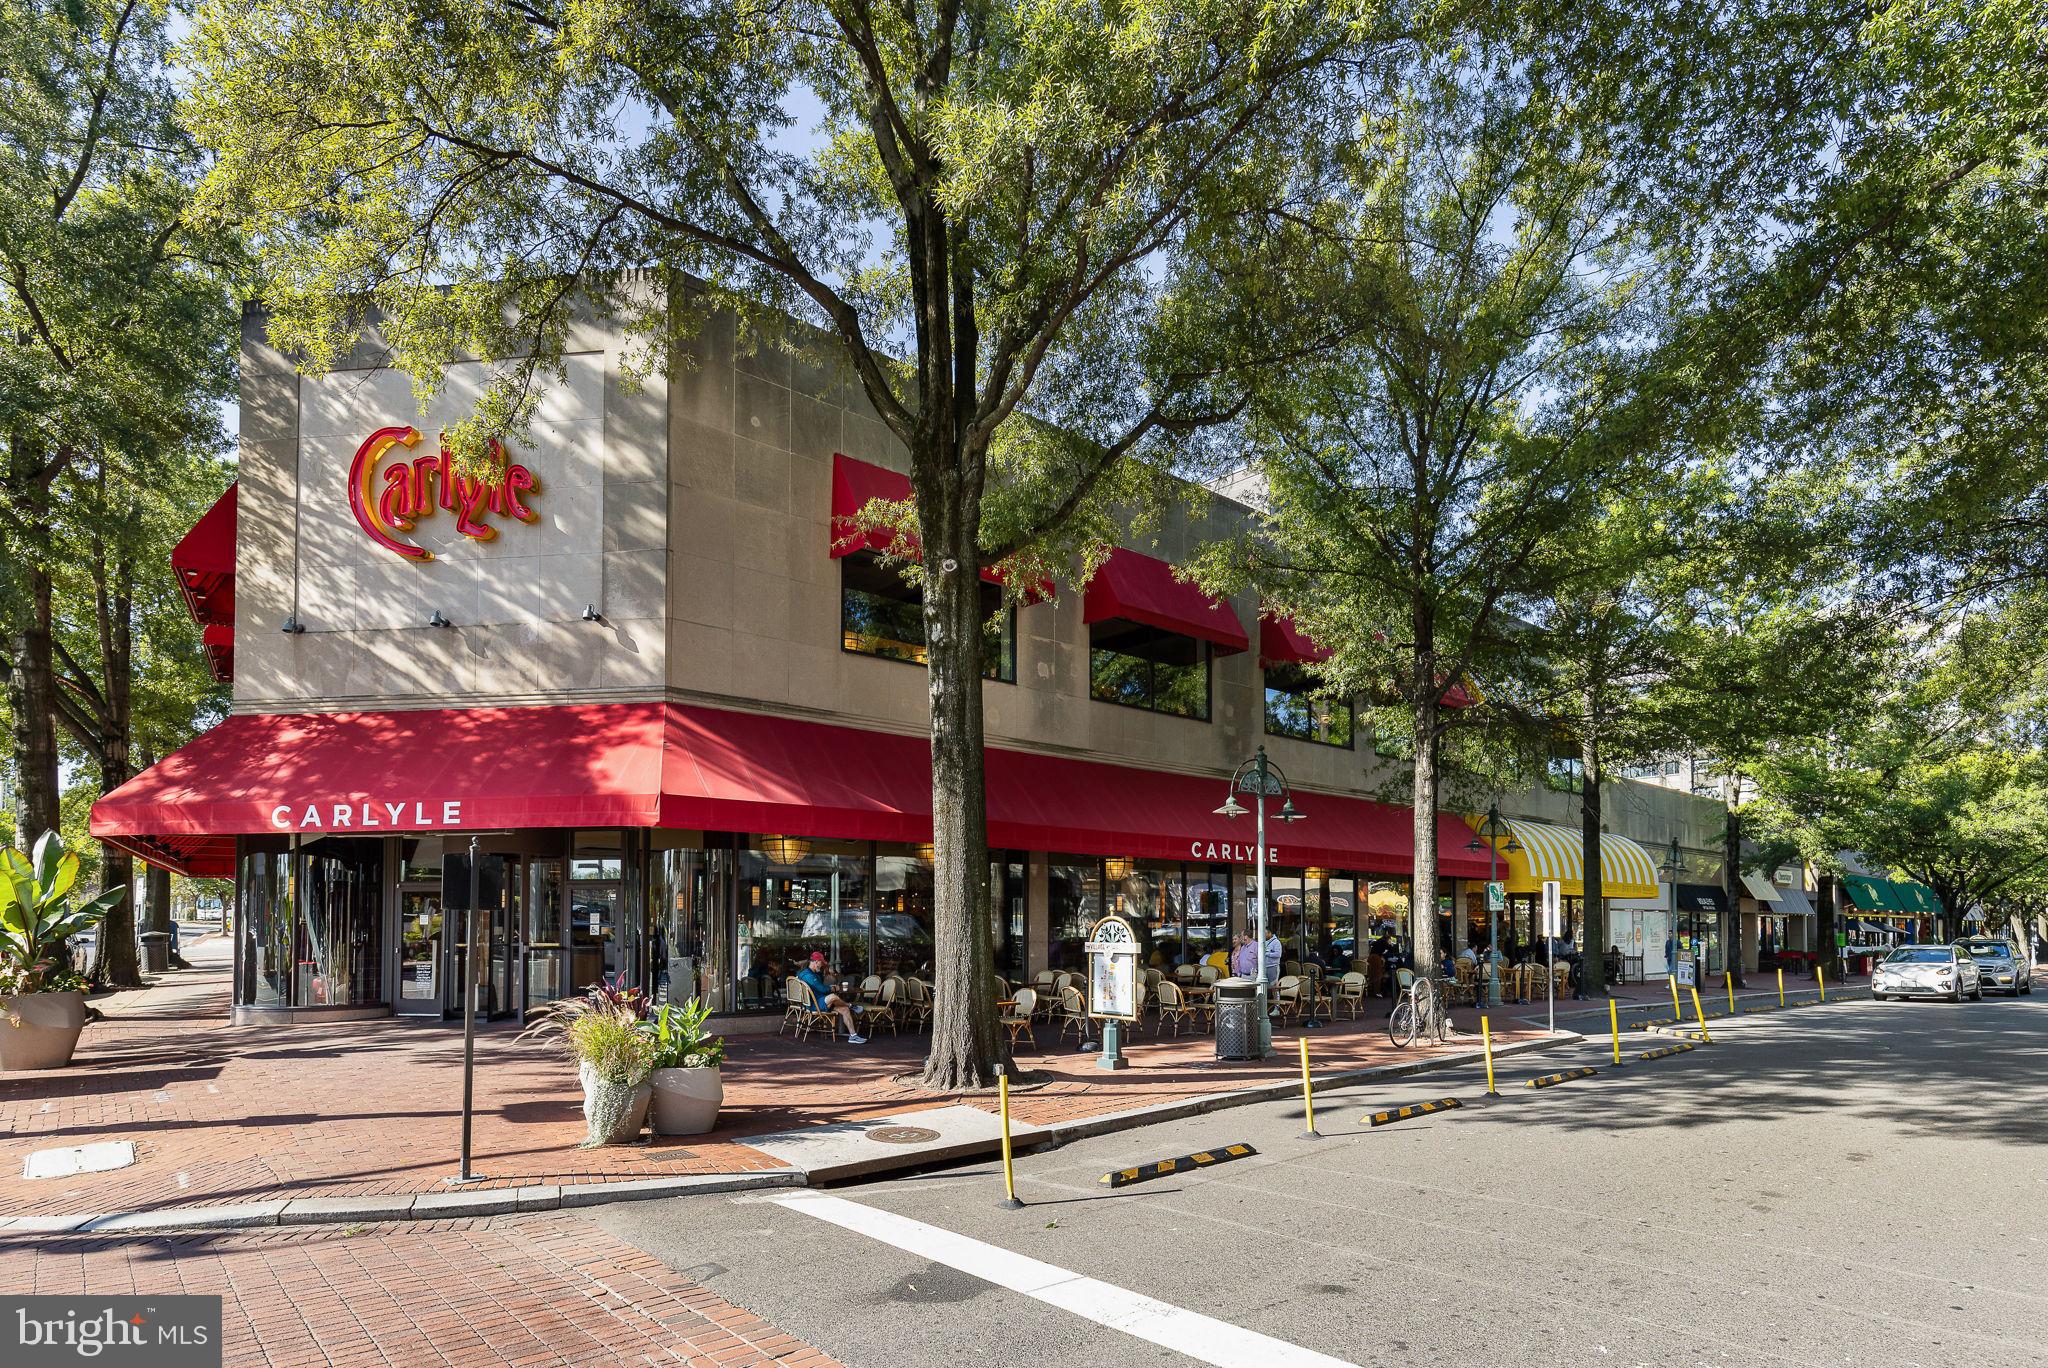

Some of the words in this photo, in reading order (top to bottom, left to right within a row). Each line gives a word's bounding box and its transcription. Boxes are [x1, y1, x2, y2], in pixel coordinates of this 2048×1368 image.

[348, 425, 541, 562] Carlyle
[271, 801, 462, 829] CARLYLE
[1191, 841, 1278, 863] CARLYE
